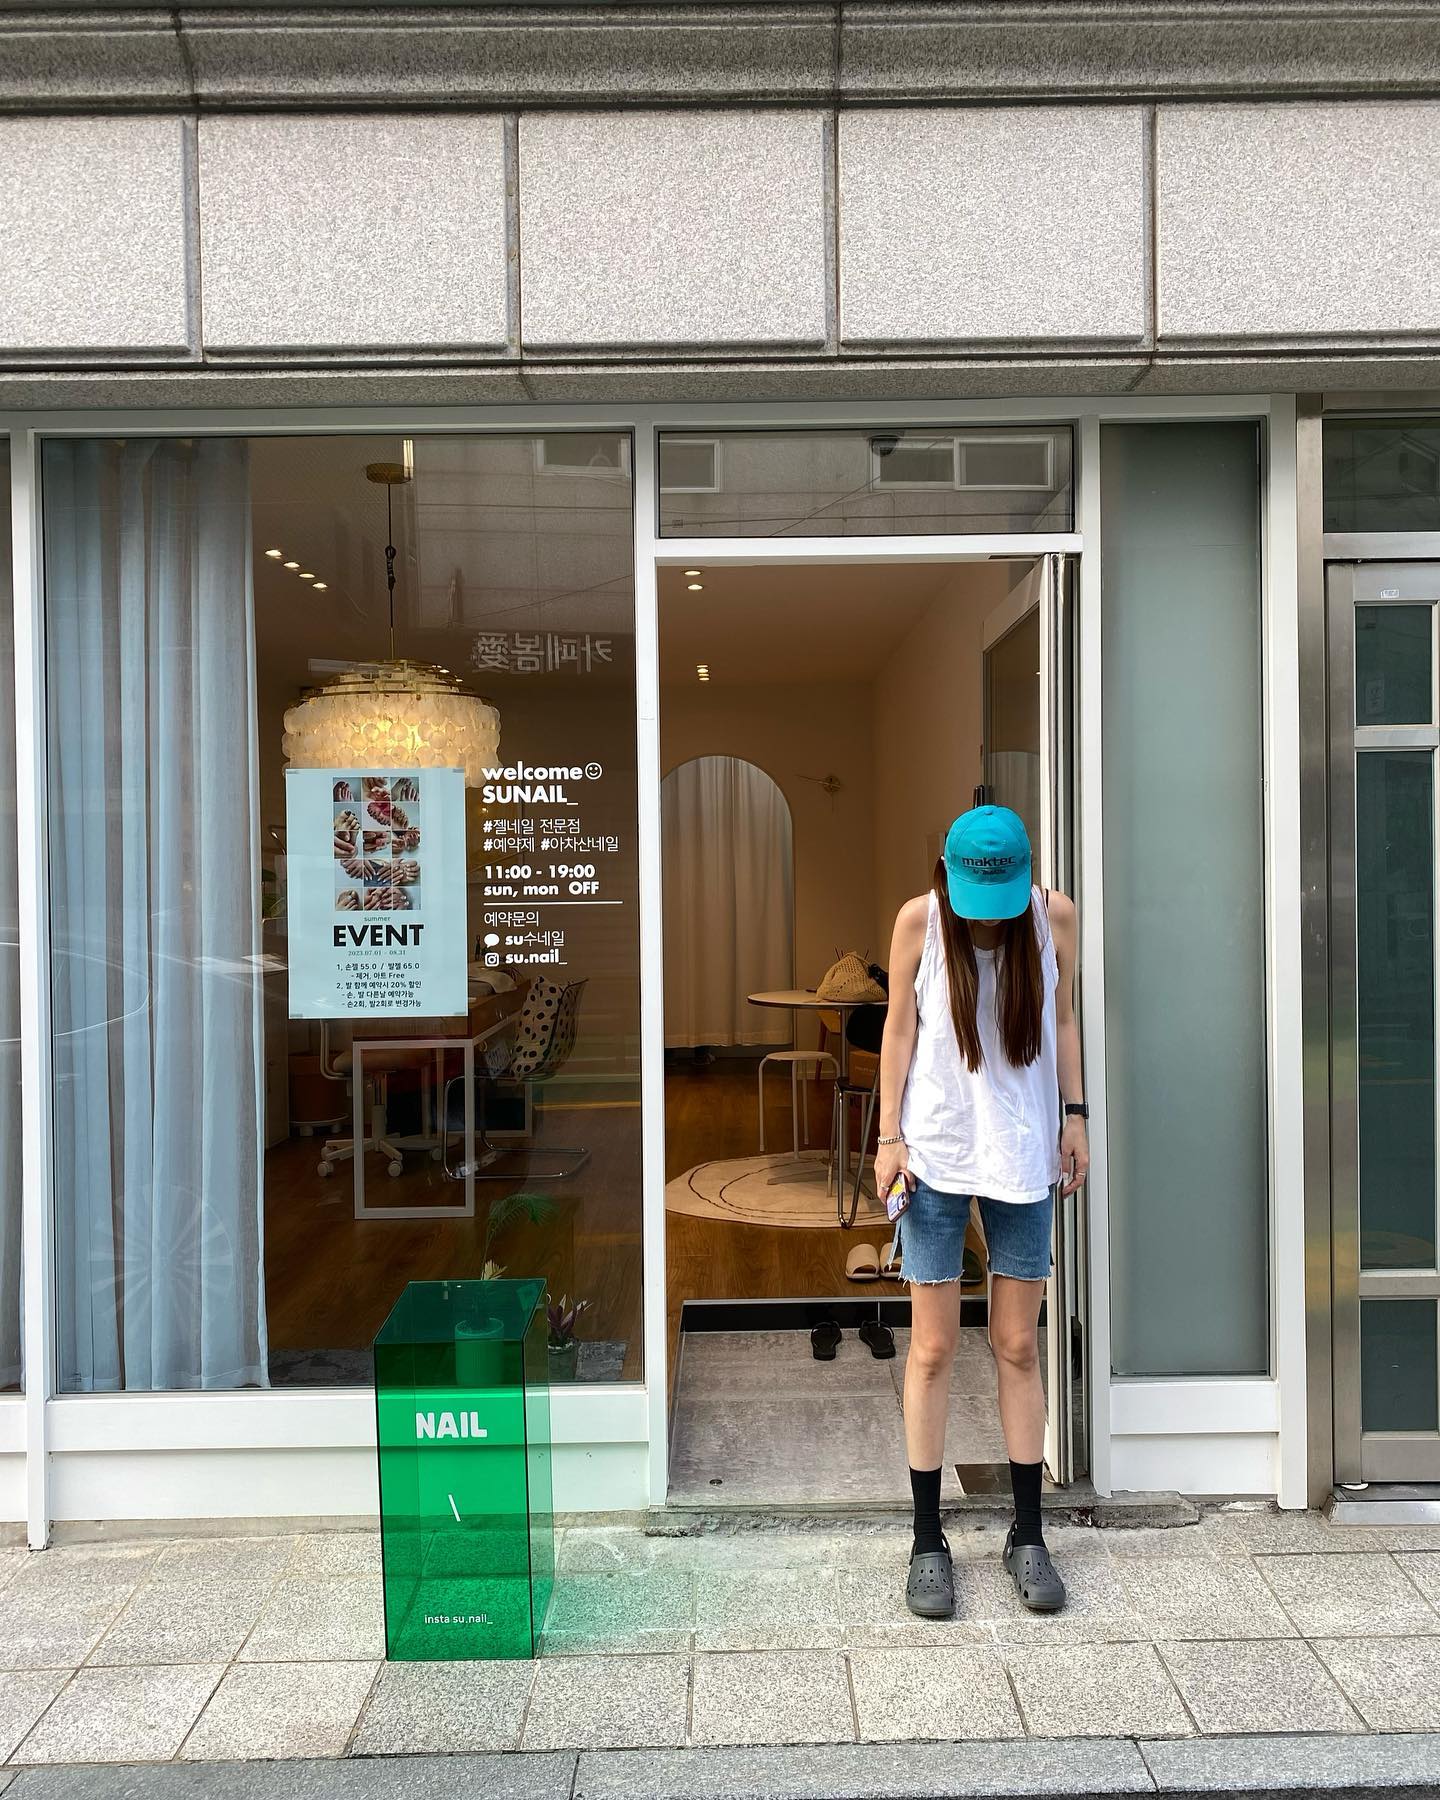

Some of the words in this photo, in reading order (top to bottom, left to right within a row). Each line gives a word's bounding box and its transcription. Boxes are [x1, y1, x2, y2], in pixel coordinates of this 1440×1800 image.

[481, 760, 583, 781] welcome
[482, 785, 579, 806] SUNAIL_
[483, 818, 534, 835] #젤네일
[540, 818, 580, 834] 전문점
[483, 837, 535, 853] #예약제
[541, 836, 619, 852] #아차산네일
[485, 865, 532, 879] 11:00
[549, 864, 596, 878] 19:00
[484, 885, 519, 898] sun,
[523, 885, 559, 896] mon
[568, 881, 600, 895] OFF
[484, 911, 539, 927] 예약문의
[333, 924, 425, 947] EVENT
[505, 930, 565, 947] su수네일
[505, 948, 568, 965] su.nail_
[390, 981, 407, 989] 20%
[415, 1411, 488, 1439] NAIL
[424, 1614, 450, 1624] insta
[452, 1613, 494, 1625] su.nail_
